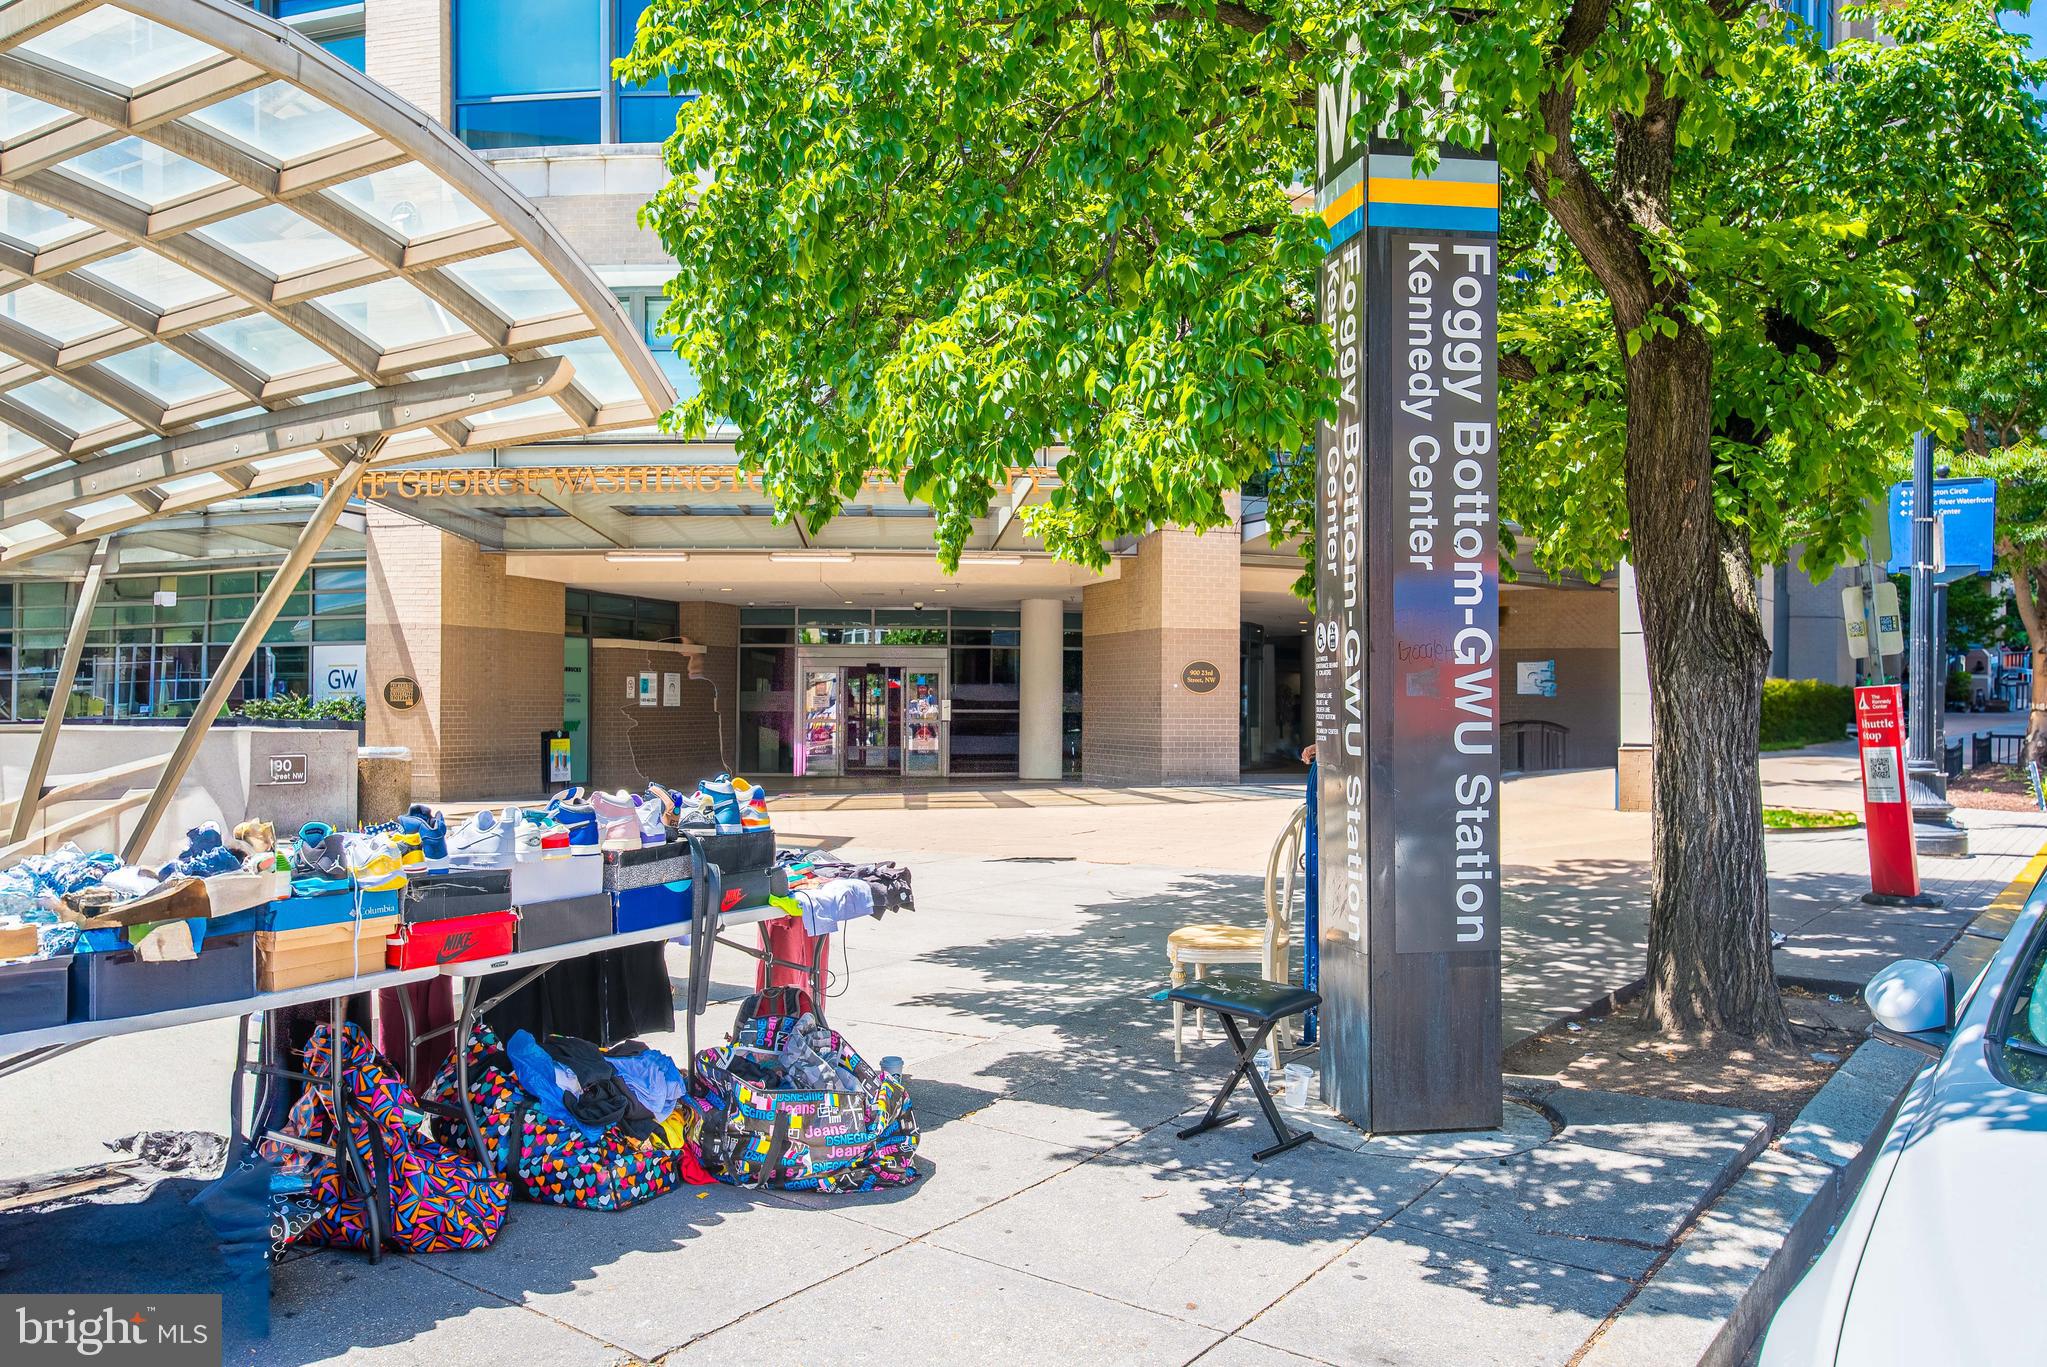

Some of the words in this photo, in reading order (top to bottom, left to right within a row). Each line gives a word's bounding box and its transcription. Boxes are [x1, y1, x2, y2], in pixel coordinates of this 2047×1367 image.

[1339, 244, 1361, 406] Foggy
[1400, 242, 1440, 422] Kennedy
[1442, 244, 1491, 404] Foggy
[397, 467, 542, 498] GEORGE
[549, 465, 766, 496] WASHINGTO
[1326, 446, 1341, 576] Center
[1407, 434, 1441, 571] Center
[1938, 508, 1961, 516] Center
[1949, 487, 1969, 495] Circle
[1956, 496, 1993, 504] Waterfront
[1343, 422, 1362, 757] Bottom-GWU
[1452, 422, 1494, 755] Bottom-GWU
[328, 669, 358, 690] GW
[292, 772, 304, 780] NW
[725, 887, 742, 901] NIKE
[1346, 774, 1363, 942] Station
[1454, 774, 1493, 942] Station
[443, 931, 473, 952] NIKE
[804, 1124, 848, 1140] Jeans
